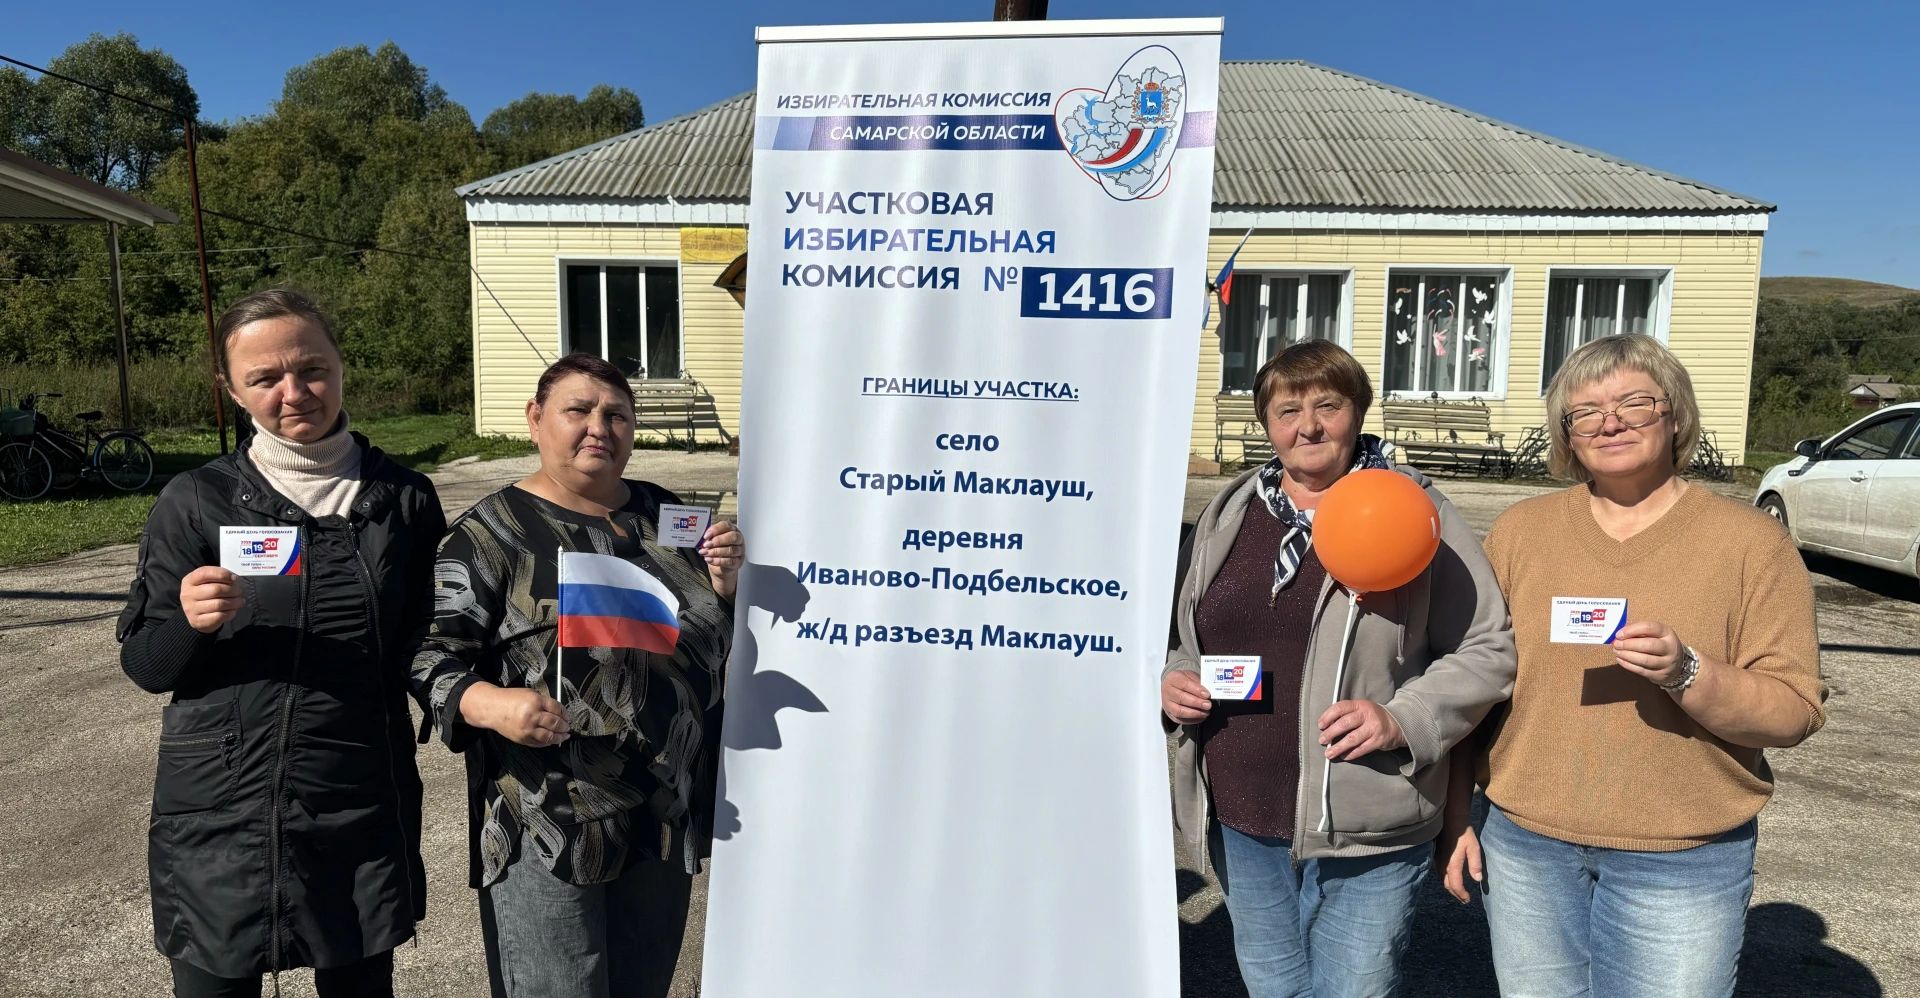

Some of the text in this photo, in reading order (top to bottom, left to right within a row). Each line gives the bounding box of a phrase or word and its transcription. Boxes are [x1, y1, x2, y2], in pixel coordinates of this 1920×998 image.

[777, 92, 1051, 109] ИЗБИРАТЕЛЬНАЯ КОМИССИЯ
[830, 121, 1045, 141] САМАРСКОЙ ОБЛАСТИ
[785, 191, 994, 216] УЧАСТКОВАЯ
[783, 228, 1056, 254] ИЗБИРАТЕЛЬНАЯ
[782, 264, 1156, 312] КОМИССИЯ № 1416
[862, 377, 1079, 400] ГРАНИЦЫ УЧАСТКА:
[936, 433, 1000, 452] село
[840, 467, 1094, 502] Старый Маклауш,
[902, 529, 1023, 553] деревня
[797, 562, 1128, 600] Иваново-Подбельское,
[797, 617, 1122, 657] ж/д разъезд Маклауш.
